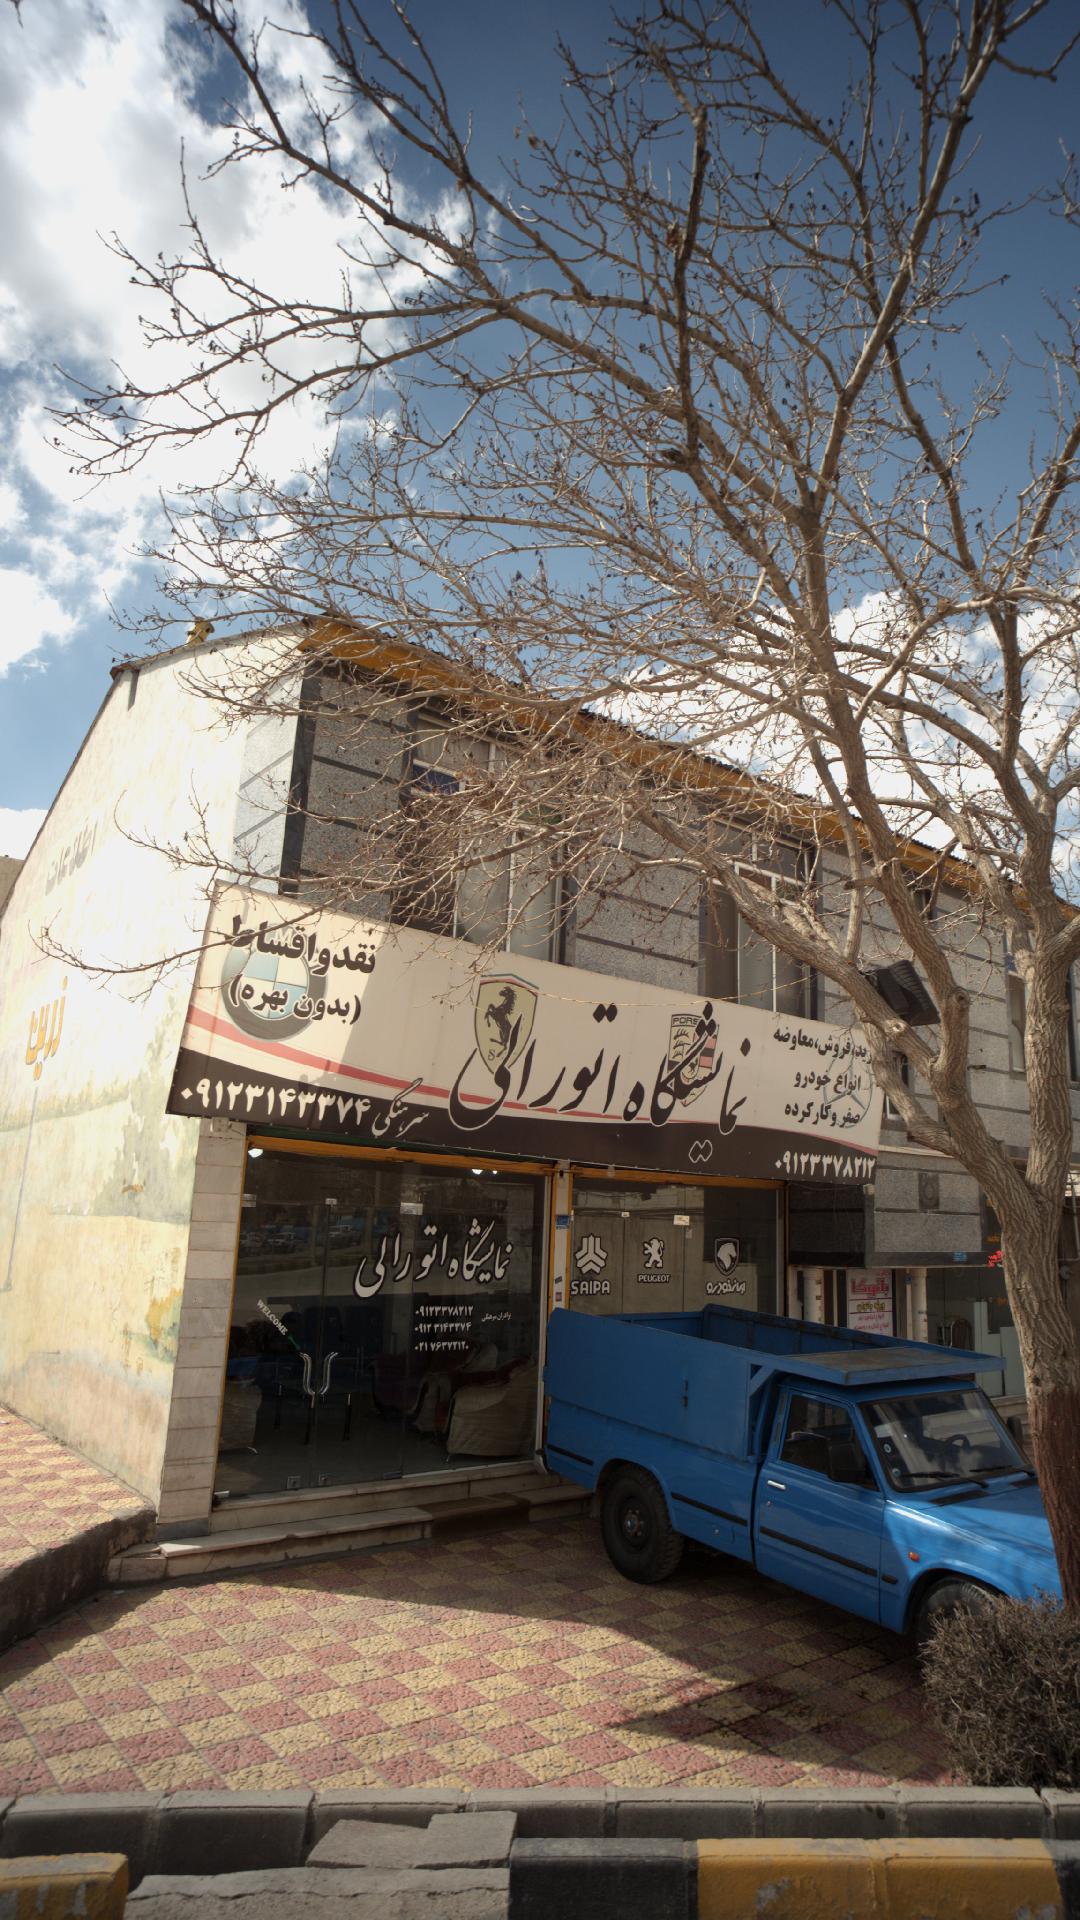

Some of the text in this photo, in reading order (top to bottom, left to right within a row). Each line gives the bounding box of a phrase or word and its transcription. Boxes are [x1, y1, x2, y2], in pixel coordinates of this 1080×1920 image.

[672, 1017, 699, 1025] PORS
[623, 1000, 752, 1164] نمایشگاه
[793, 1070, 862, 1096] انواع خودرو
[180, 1077, 372, 1126] ۰۹۱۲۳۱۴۳۳۷۴
[775, 1150, 876, 1179] ۰۹۱۲۳۳۷۸۲۱۲
[447, 1217, 513, 1283] نمایشگاه
[571, 1280, 611, 1296] SAIPA
[637, 1274, 671, 1283] PEUGEOT
[256, 1298, 289, 1336] WELCOME
